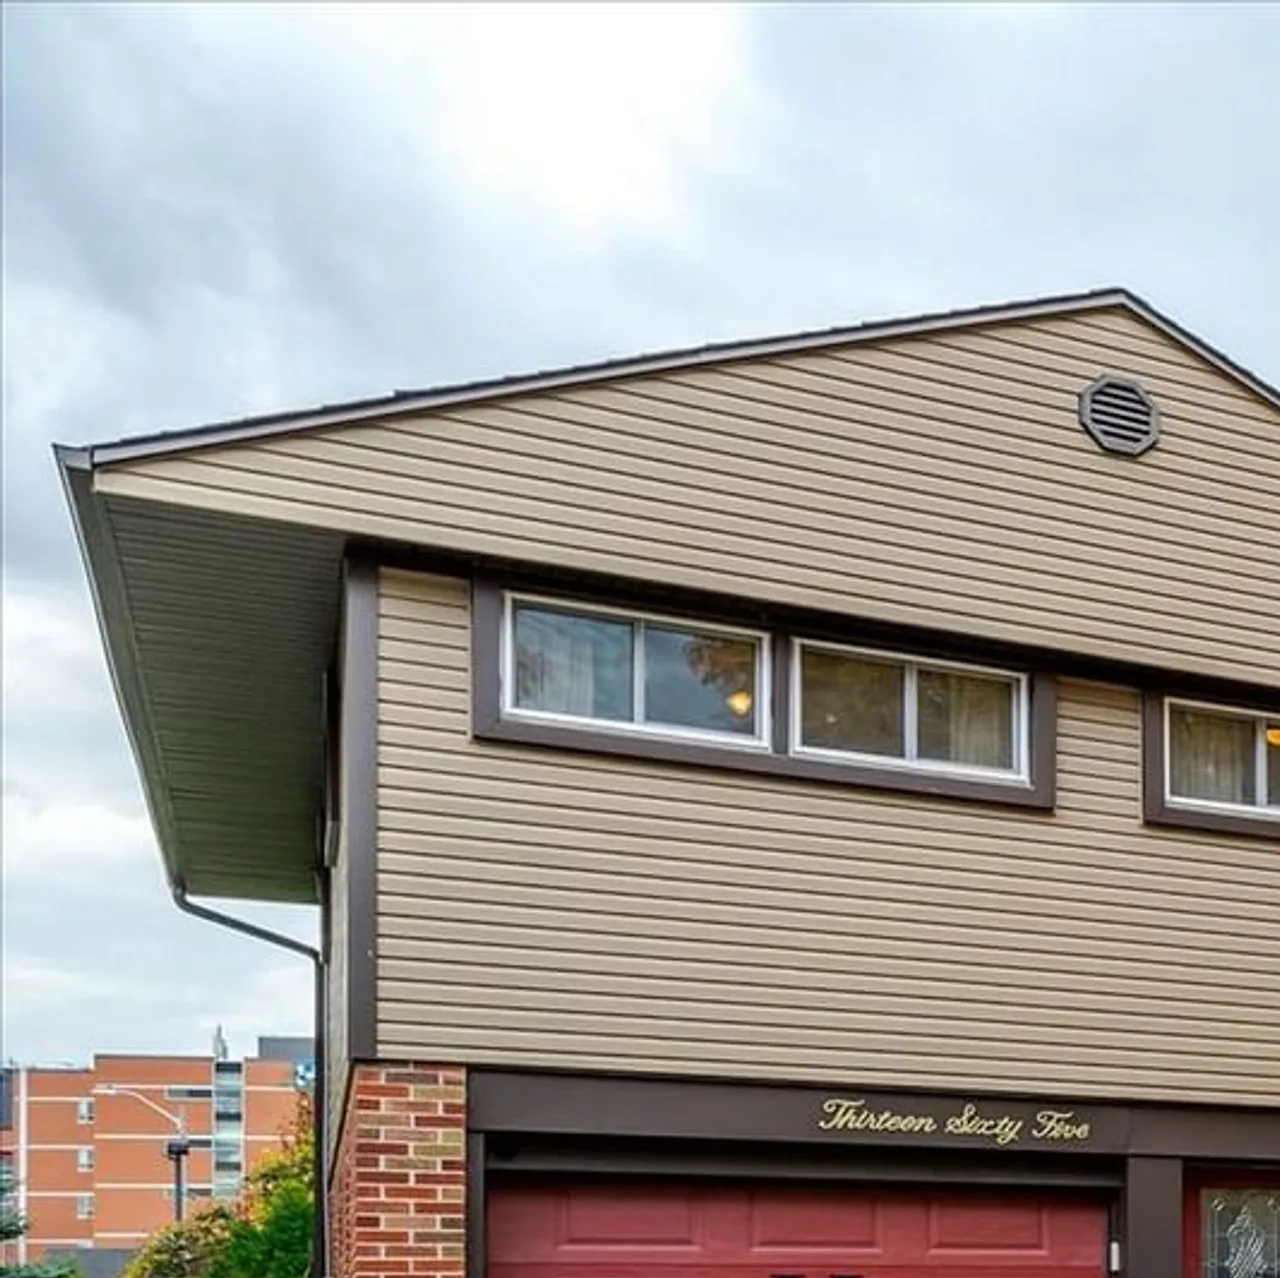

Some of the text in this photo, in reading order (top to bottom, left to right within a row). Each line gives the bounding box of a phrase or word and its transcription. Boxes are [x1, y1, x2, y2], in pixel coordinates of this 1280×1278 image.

[819, 1098, 1091, 1144] Thirteen Sixty Five
